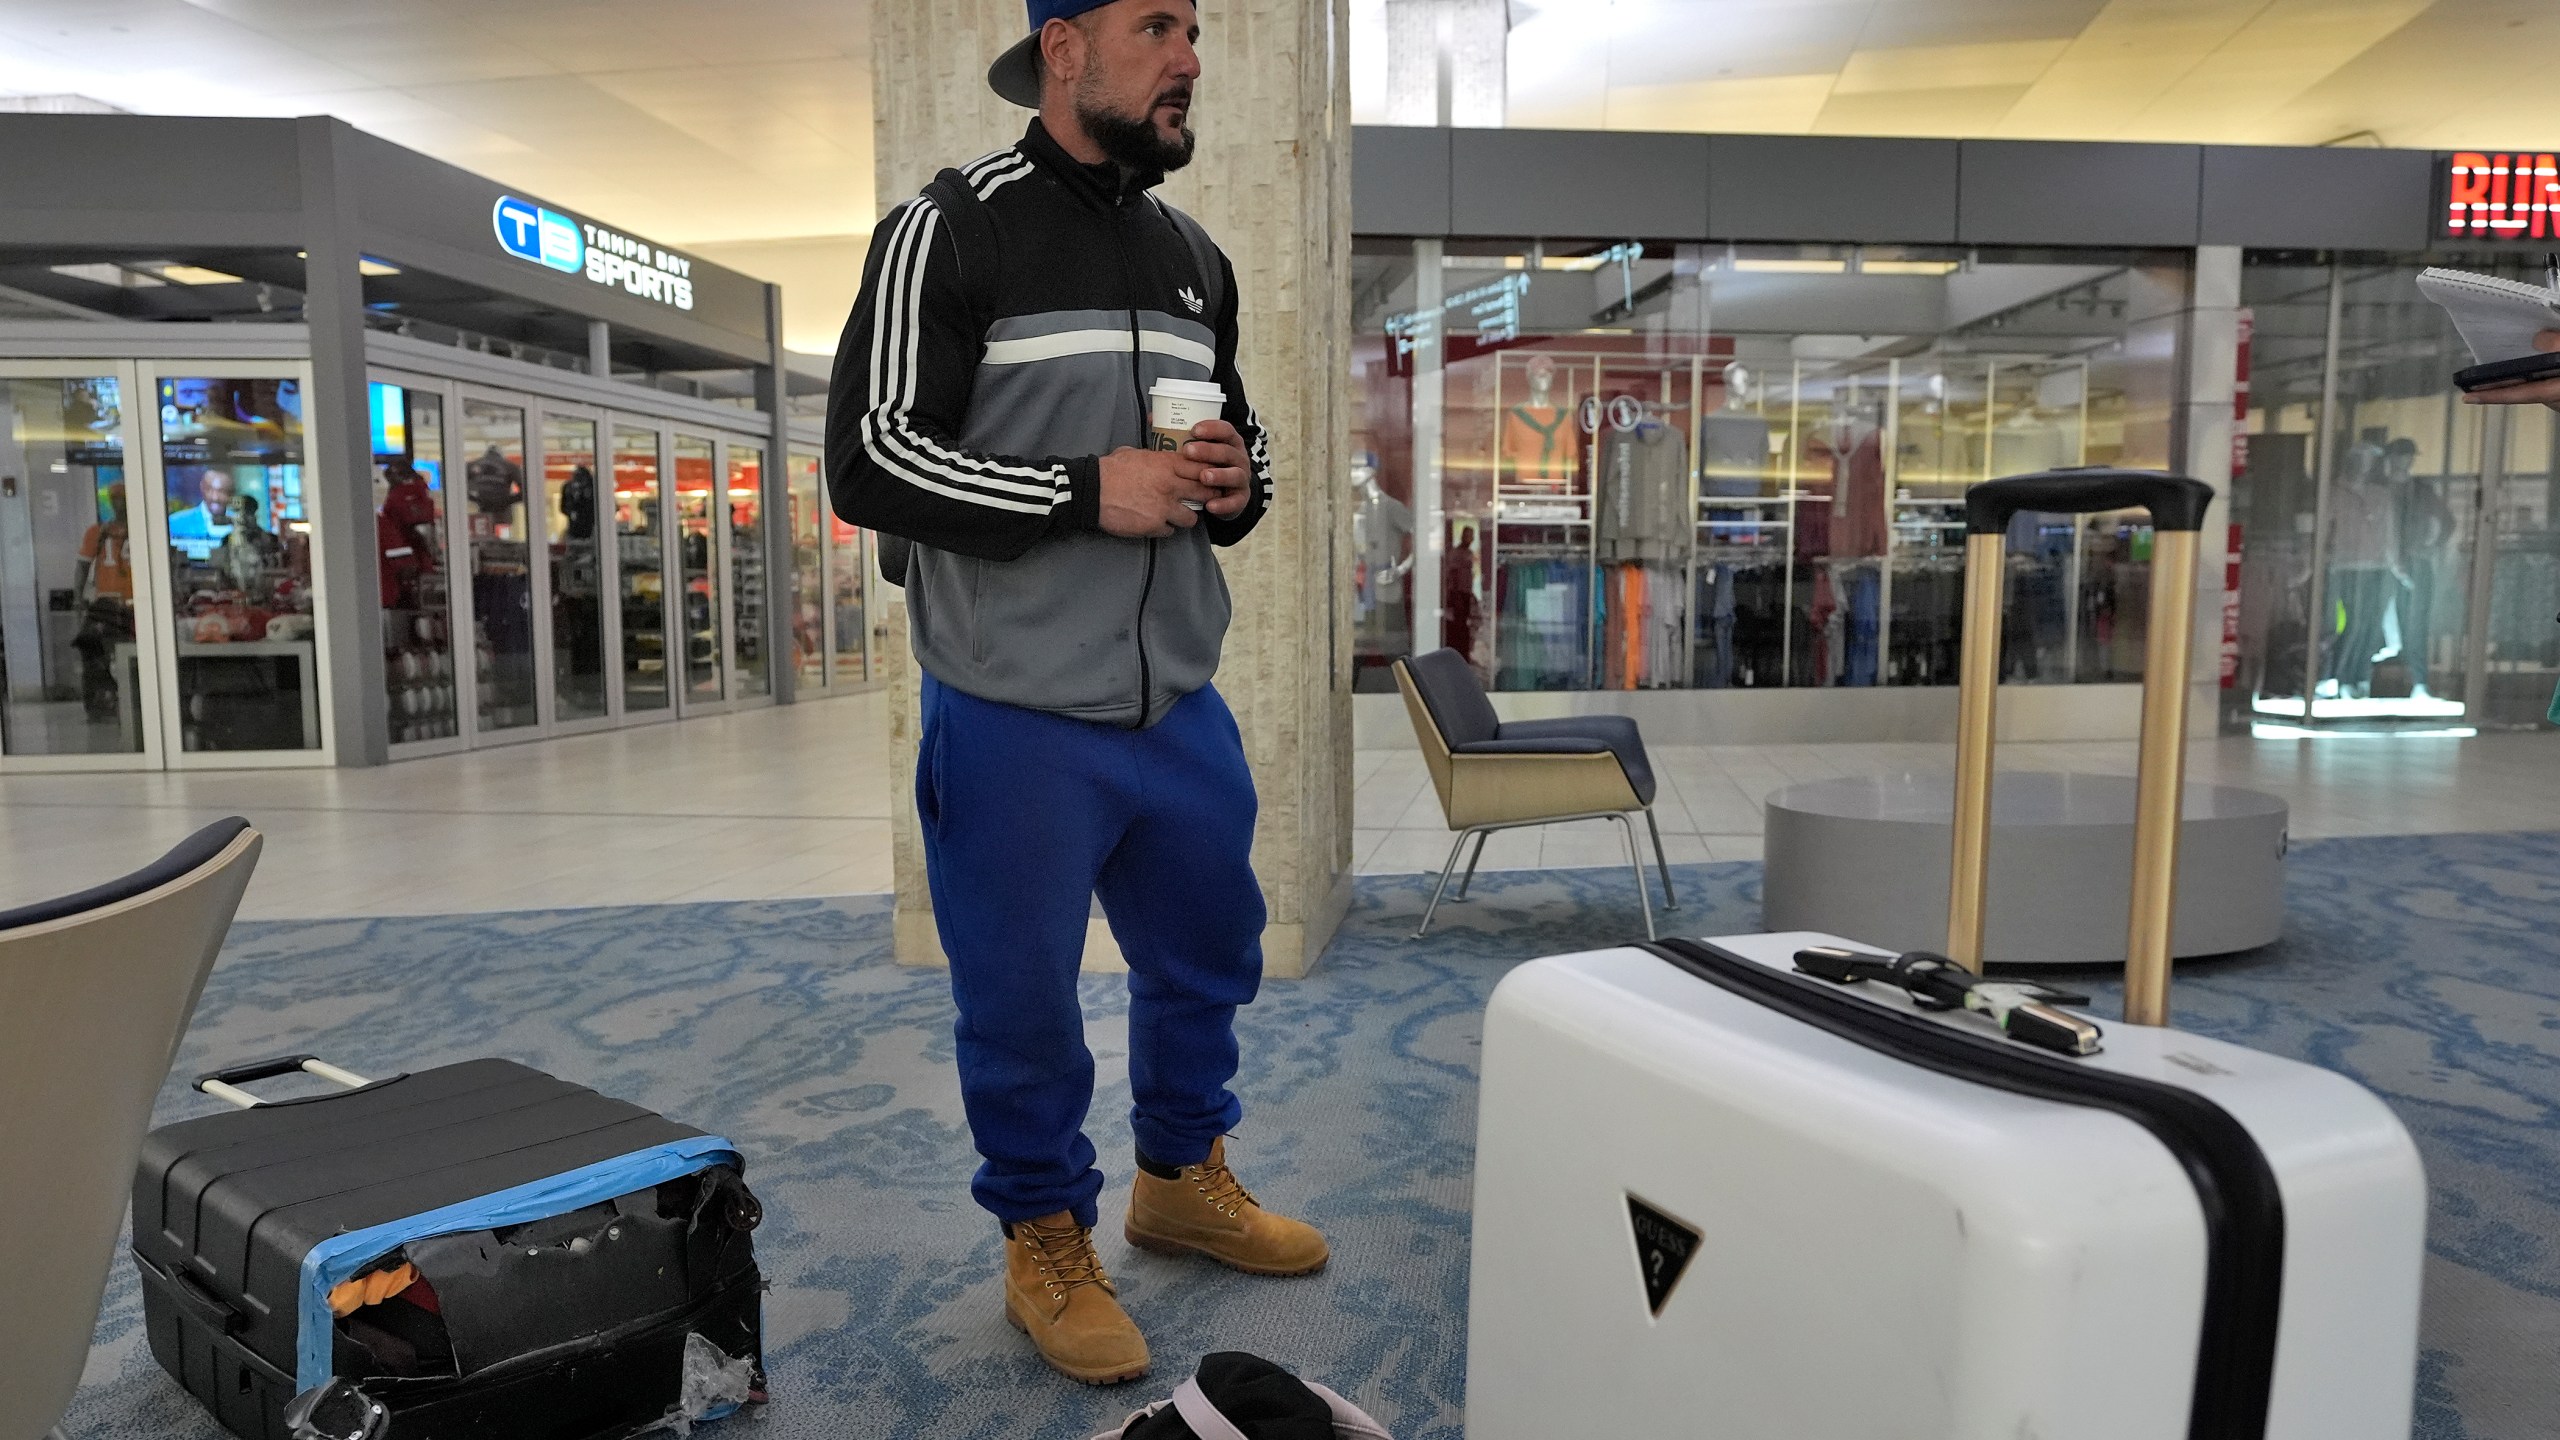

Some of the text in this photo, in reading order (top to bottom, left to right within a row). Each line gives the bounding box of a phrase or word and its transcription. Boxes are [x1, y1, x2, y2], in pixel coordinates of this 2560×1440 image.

[501, 205, 579, 265] TB
[583, 224, 691, 278] TAMPA BAY
[584, 246, 694, 311] SPORTS
[1634, 1213, 1687, 1258] GUESS
[1650, 1248, 1665, 1288] ?
